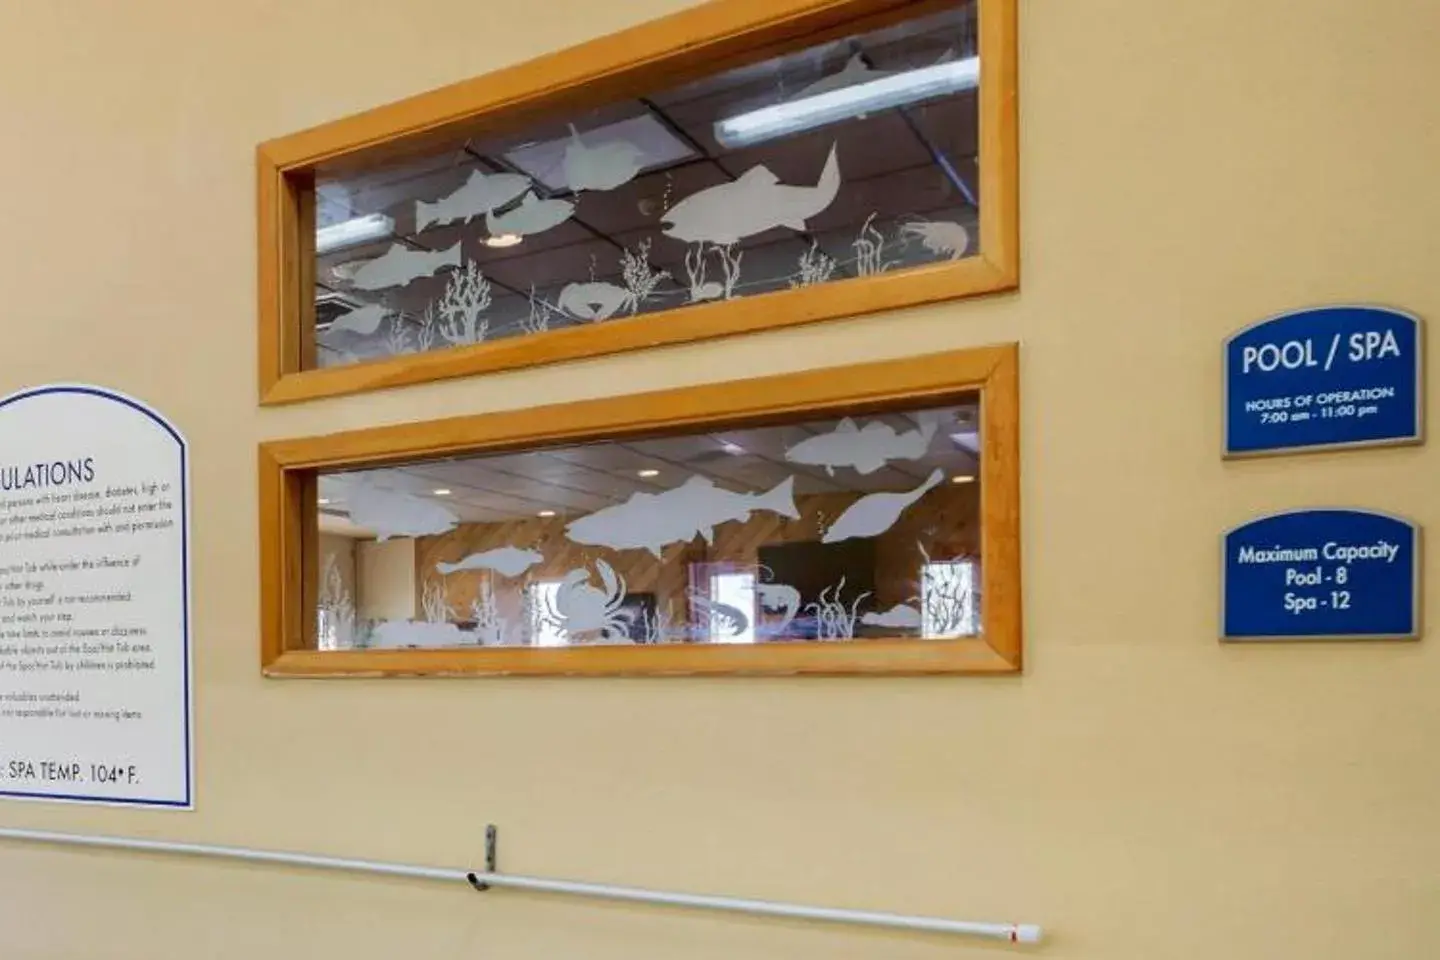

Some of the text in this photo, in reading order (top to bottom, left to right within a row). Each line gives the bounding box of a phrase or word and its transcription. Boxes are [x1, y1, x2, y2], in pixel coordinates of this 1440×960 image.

[1243, 328, 1401, 374] POOL / SPA
[1245, 386, 1395, 413] HOURS OF OPERATION
[1260, 411, 1288, 424] 7:00
[1290, 412, 1310, 422] am
[1321, 405, 1355, 418] 11:00
[1357, 405, 1378, 417] pm
[1238, 540, 1400, 564] Maximum Capacity
[1285, 566, 1323, 586] Pool
[1335, 565, 1348, 585] 8
[1284, 592, 1317, 615] Spa
[1330, 590, 1351, 609] 12
[8, 760, 36, 779] SPA
[40, 762, 84, 782] TEMP.
